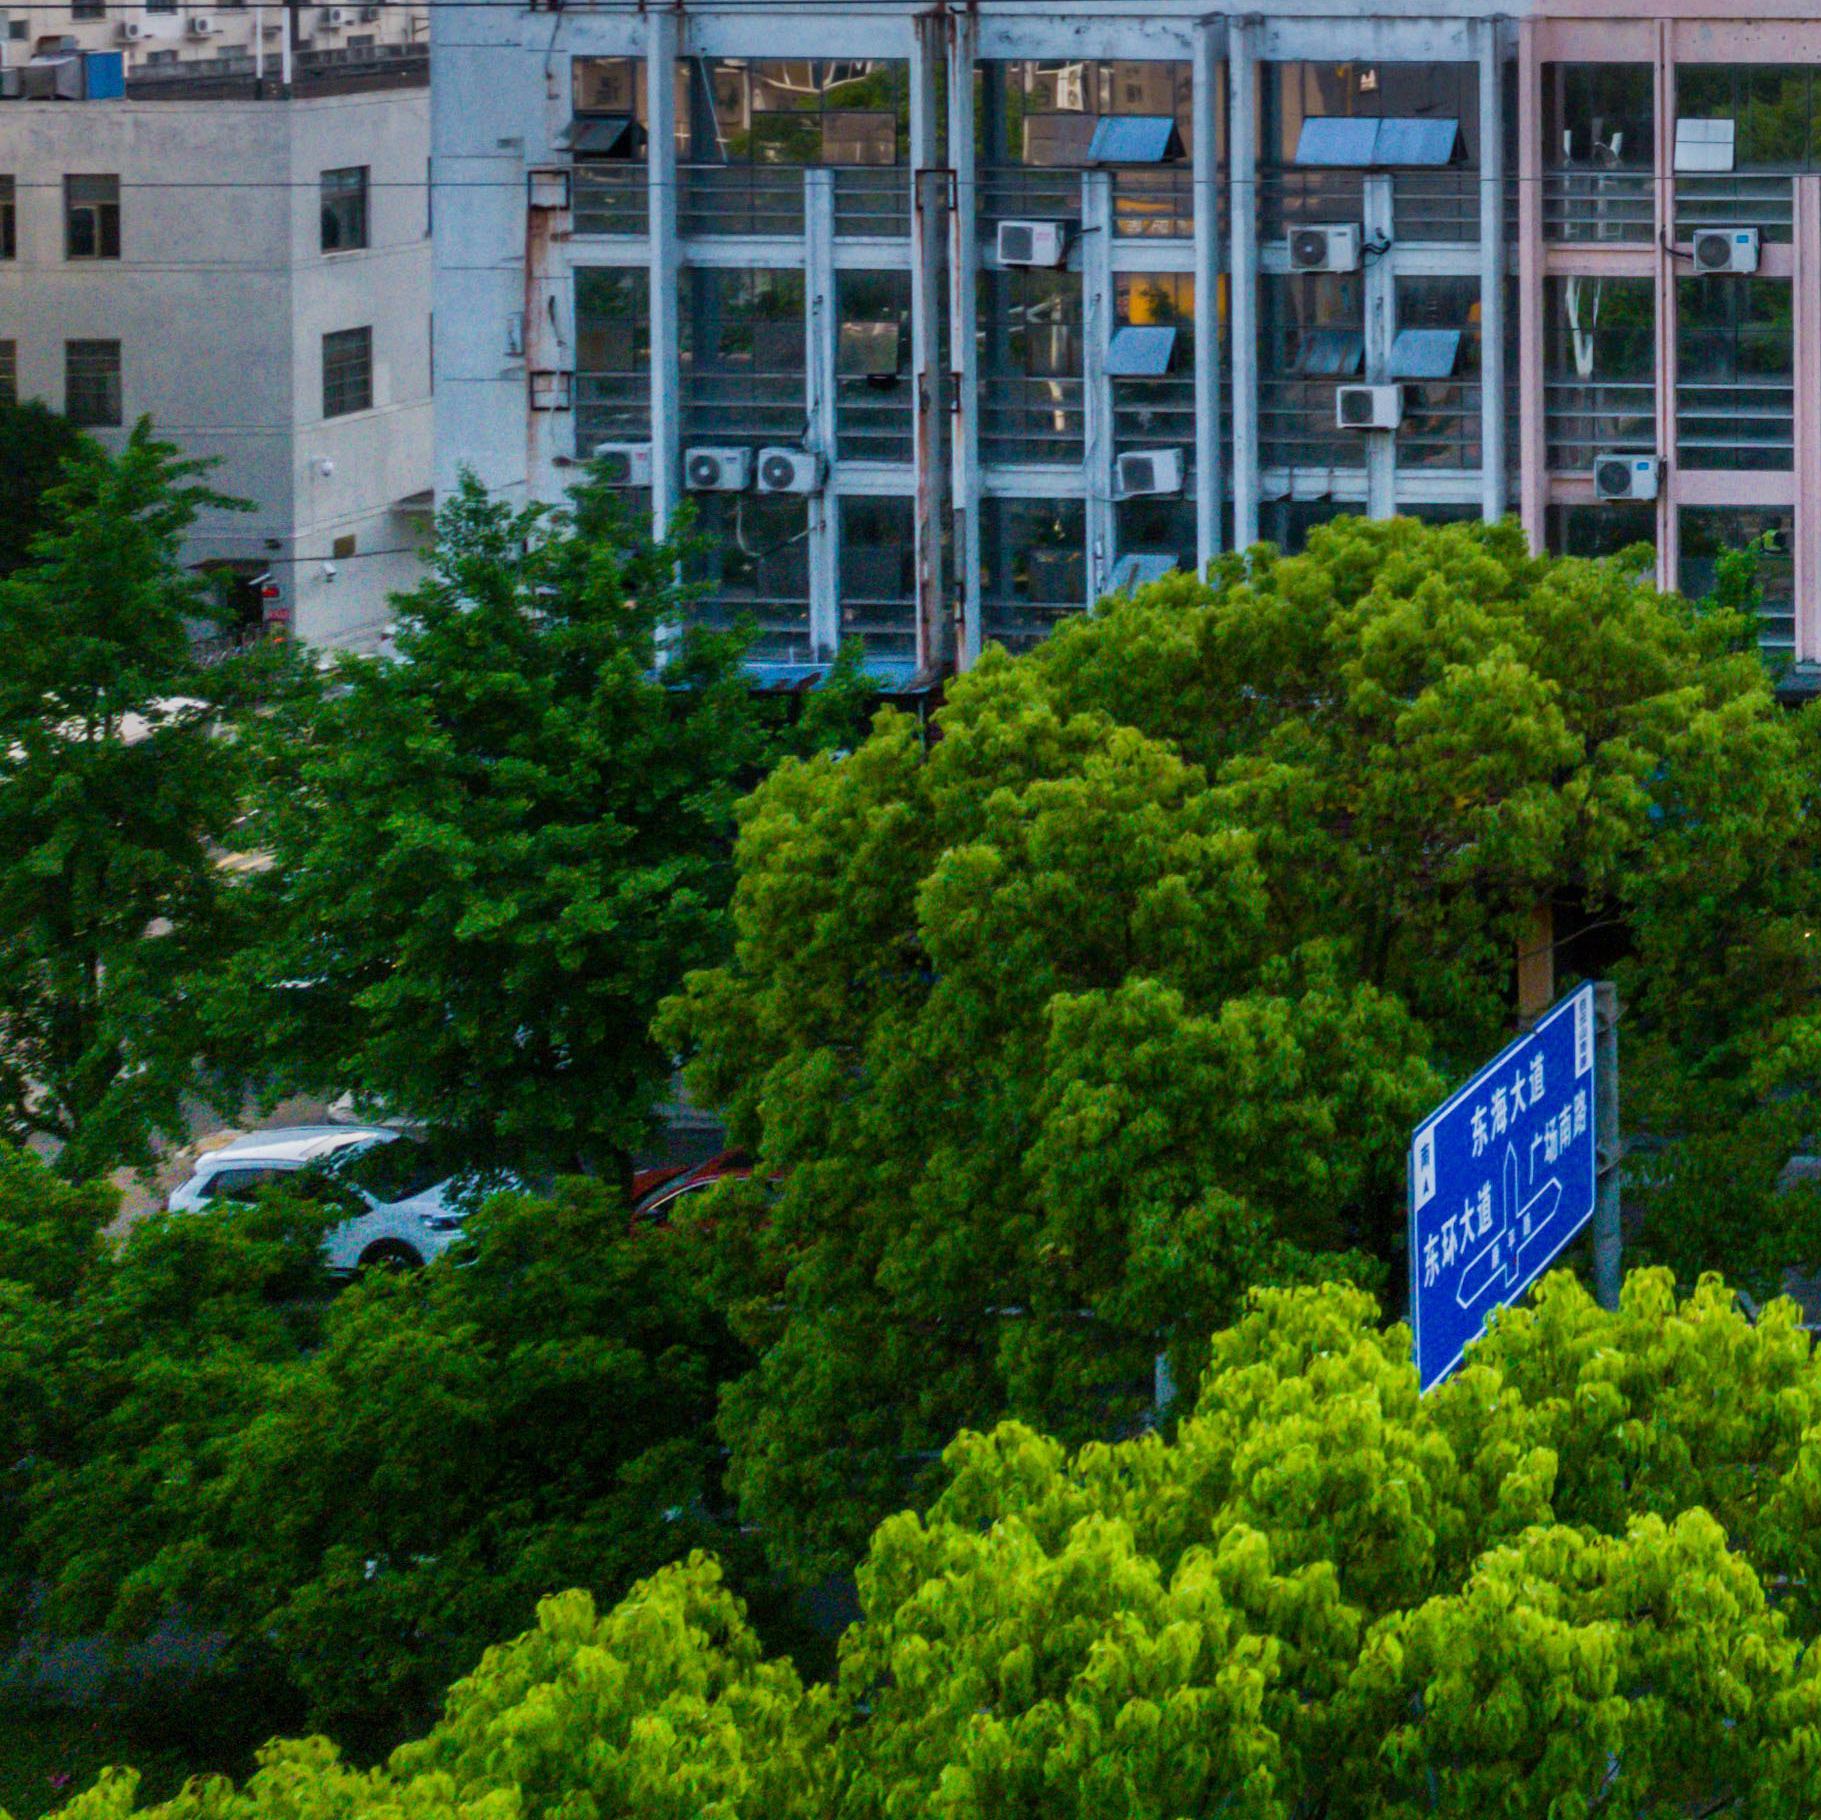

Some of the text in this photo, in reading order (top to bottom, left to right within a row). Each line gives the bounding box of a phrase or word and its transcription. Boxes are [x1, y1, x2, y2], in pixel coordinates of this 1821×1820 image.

[1469, 1050, 1546, 1159] 东海大道
[1528, 1088, 1588, 1184] 广场南路
[1423, 1180, 1494, 1288] 东环大道
